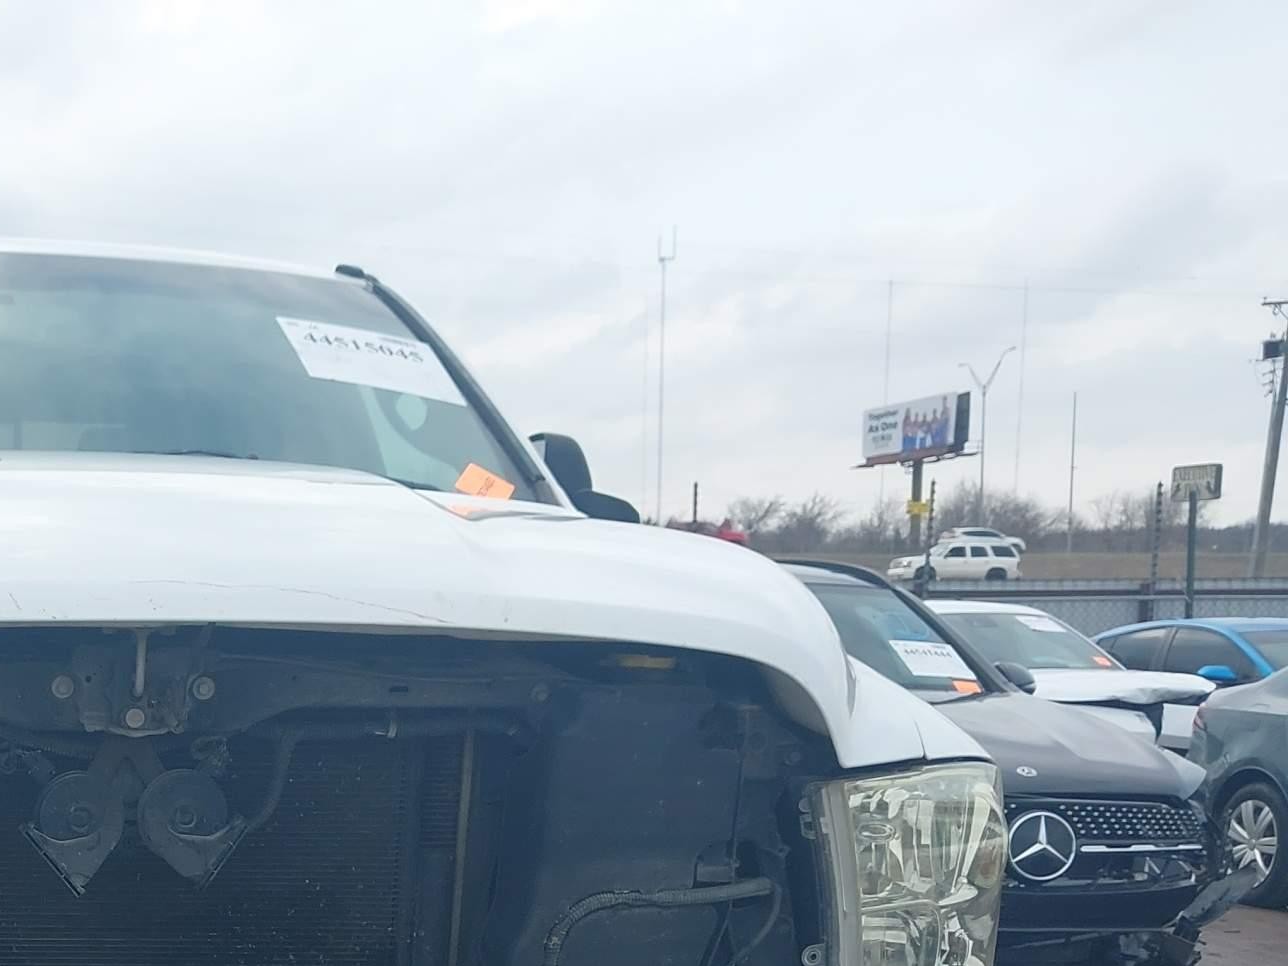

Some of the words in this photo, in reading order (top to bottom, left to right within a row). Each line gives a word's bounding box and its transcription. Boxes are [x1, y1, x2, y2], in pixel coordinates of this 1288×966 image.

[303, 331, 425, 364] 44515045
[867, 424, 880, 434] As
[880, 421, 898, 432] One
